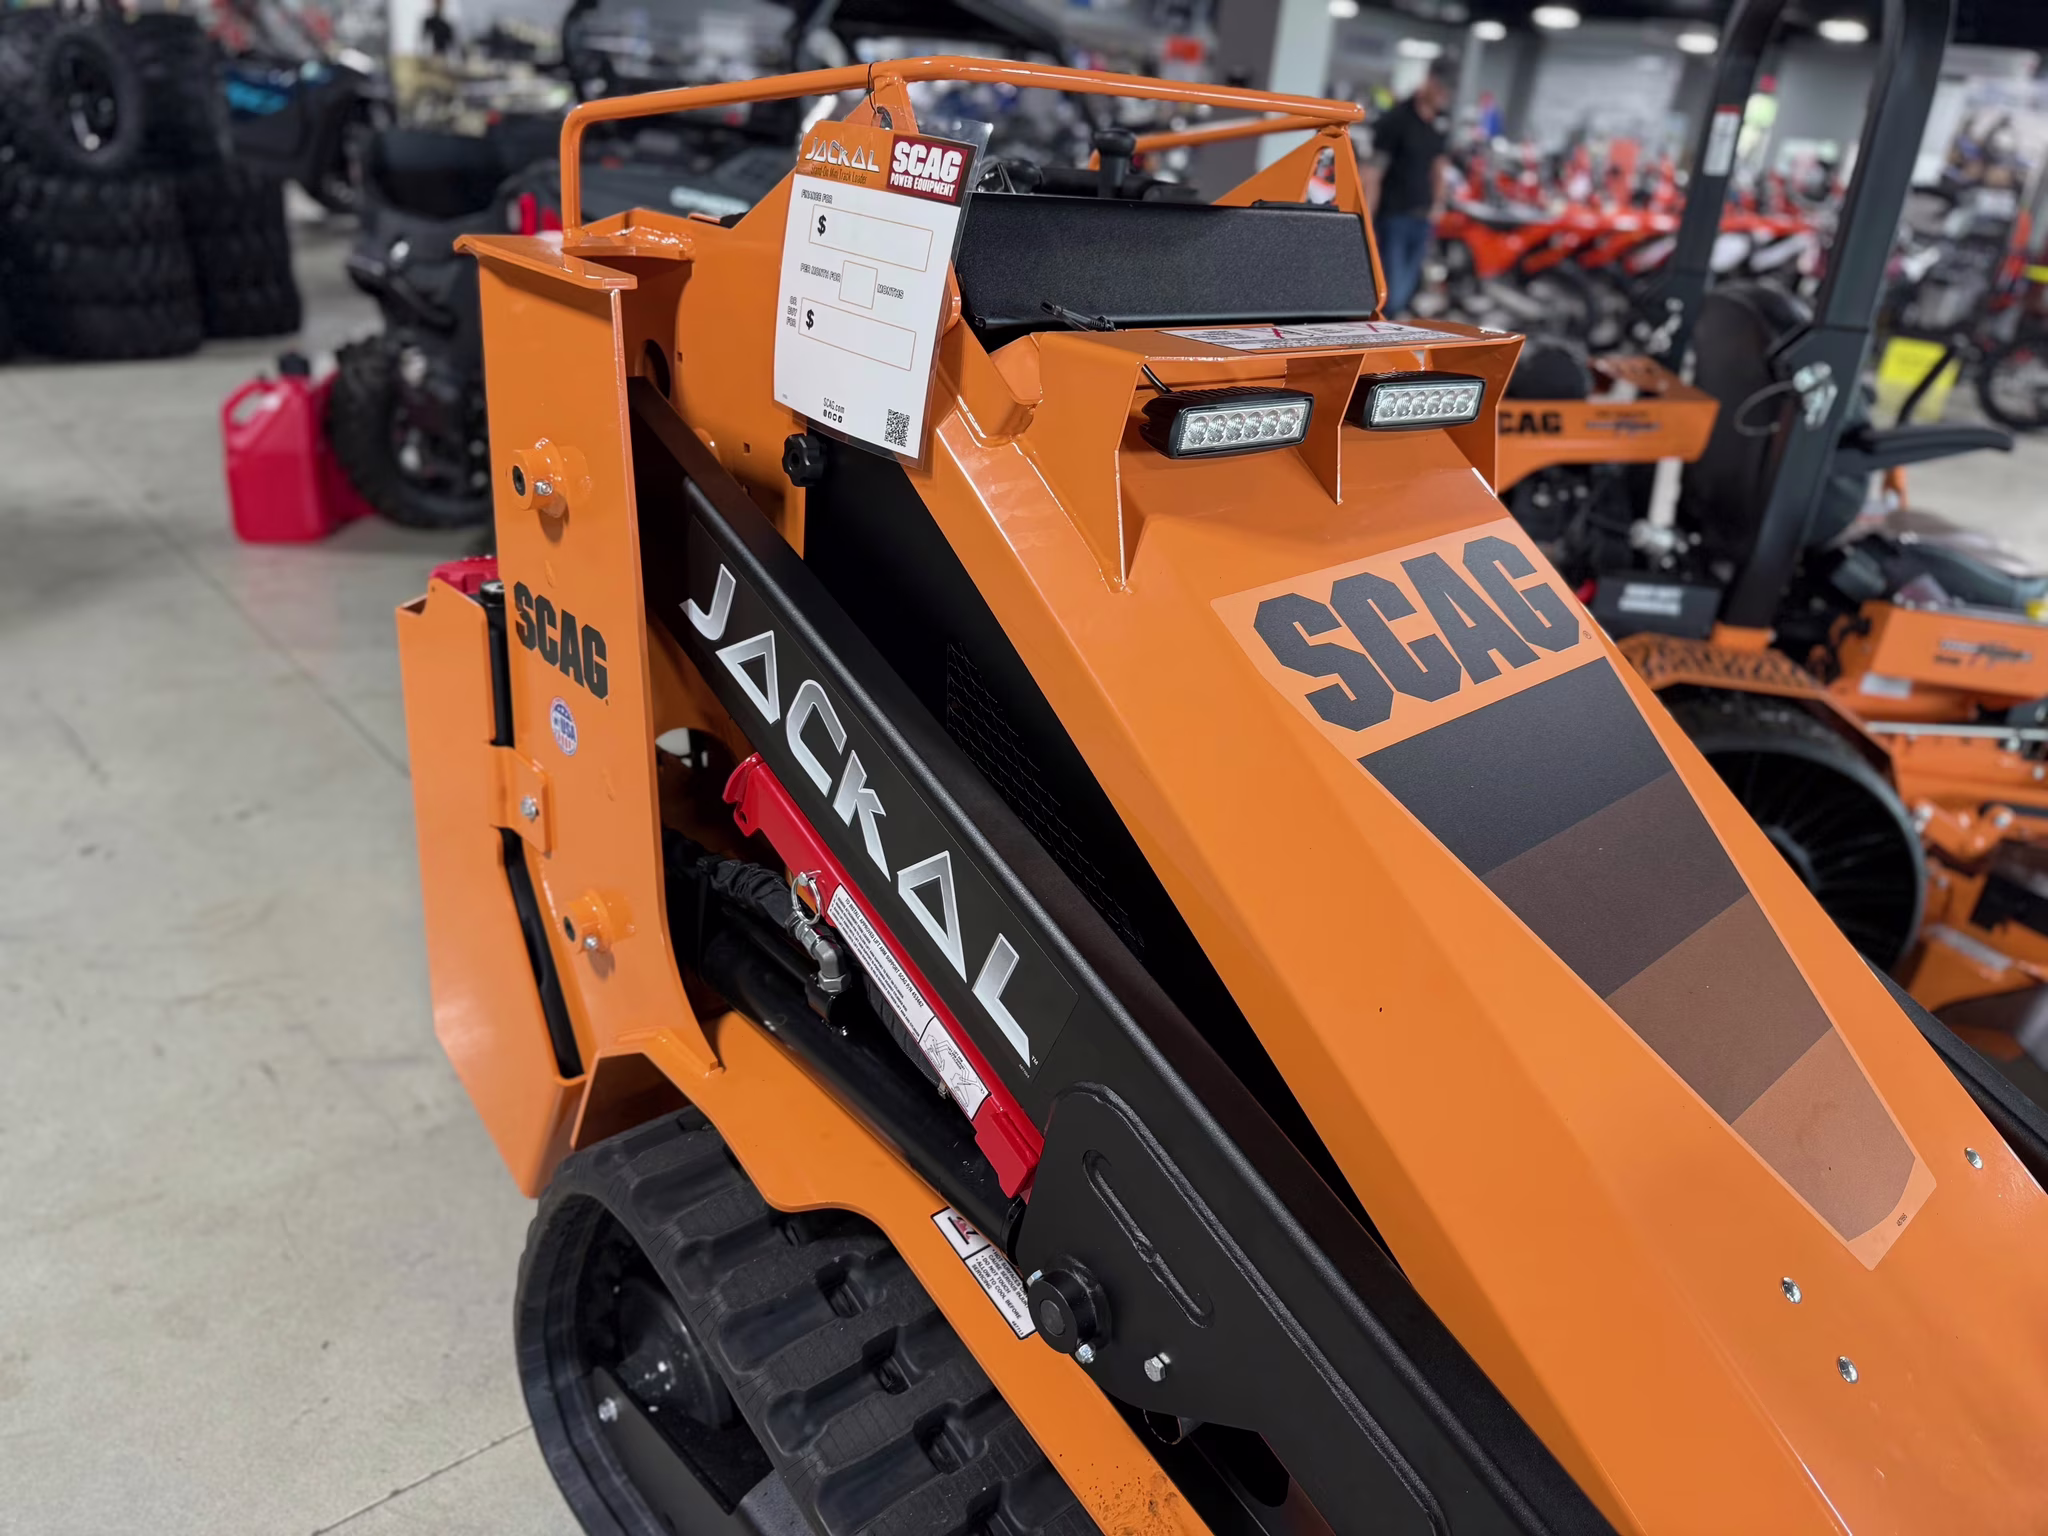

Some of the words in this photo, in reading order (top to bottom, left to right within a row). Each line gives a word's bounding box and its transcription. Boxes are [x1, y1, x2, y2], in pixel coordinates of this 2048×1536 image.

[805, 136, 880, 173] JACKAL
[892, 141, 963, 184] SCAG
[851, 172, 867, 185] Loader
[890, 173, 912, 190] POWER
[913, 177, 956, 197] EQUIPMENT
[817, 214, 827, 237] $
[800, 263, 810, 274] PER
[811, 265, 829, 279] MONTH
[830, 271, 841, 283] FOR
[877, 284, 904, 299] MONTHS
[805, 309, 815, 331] $
[823, 398, 845, 414] SCAG.com
[1497, 410, 1563, 435] CAG
[513, 580, 609, 700] SCAG
[1252, 535, 1580, 732] SCAG
[560, 716, 577, 743] USA
[679, 563, 1032, 1069] JACKAL
[849, 903, 861, 919] INSTALL
[859, 918, 874, 939] APPROVED
[872, 937, 881, 947] LIFT
[878, 946, 888, 956] ARM
[885, 954, 900, 974] SUPPORT
[898, 972, 908, 985] SCAG
[971, 1263, 992, 1290] SERVICING
[982, 1257, 991, 1266] DO
[988, 1265, 999, 1277] NOT
[996, 1276, 1011, 1294] TOUCH
[988, 1254, 1003, 1271] CAUSE
[1000, 1270, 1018, 1292] SERIOUS
[1001, 1261, 1021, 1287] SURFACES
[976, 1261, 992, 1278] ALLOW
[989, 1277, 997, 1286] TO
[994, 1285, 1006, 1300] COOL
[1005, 1299, 1022, 1320] BEFORE
